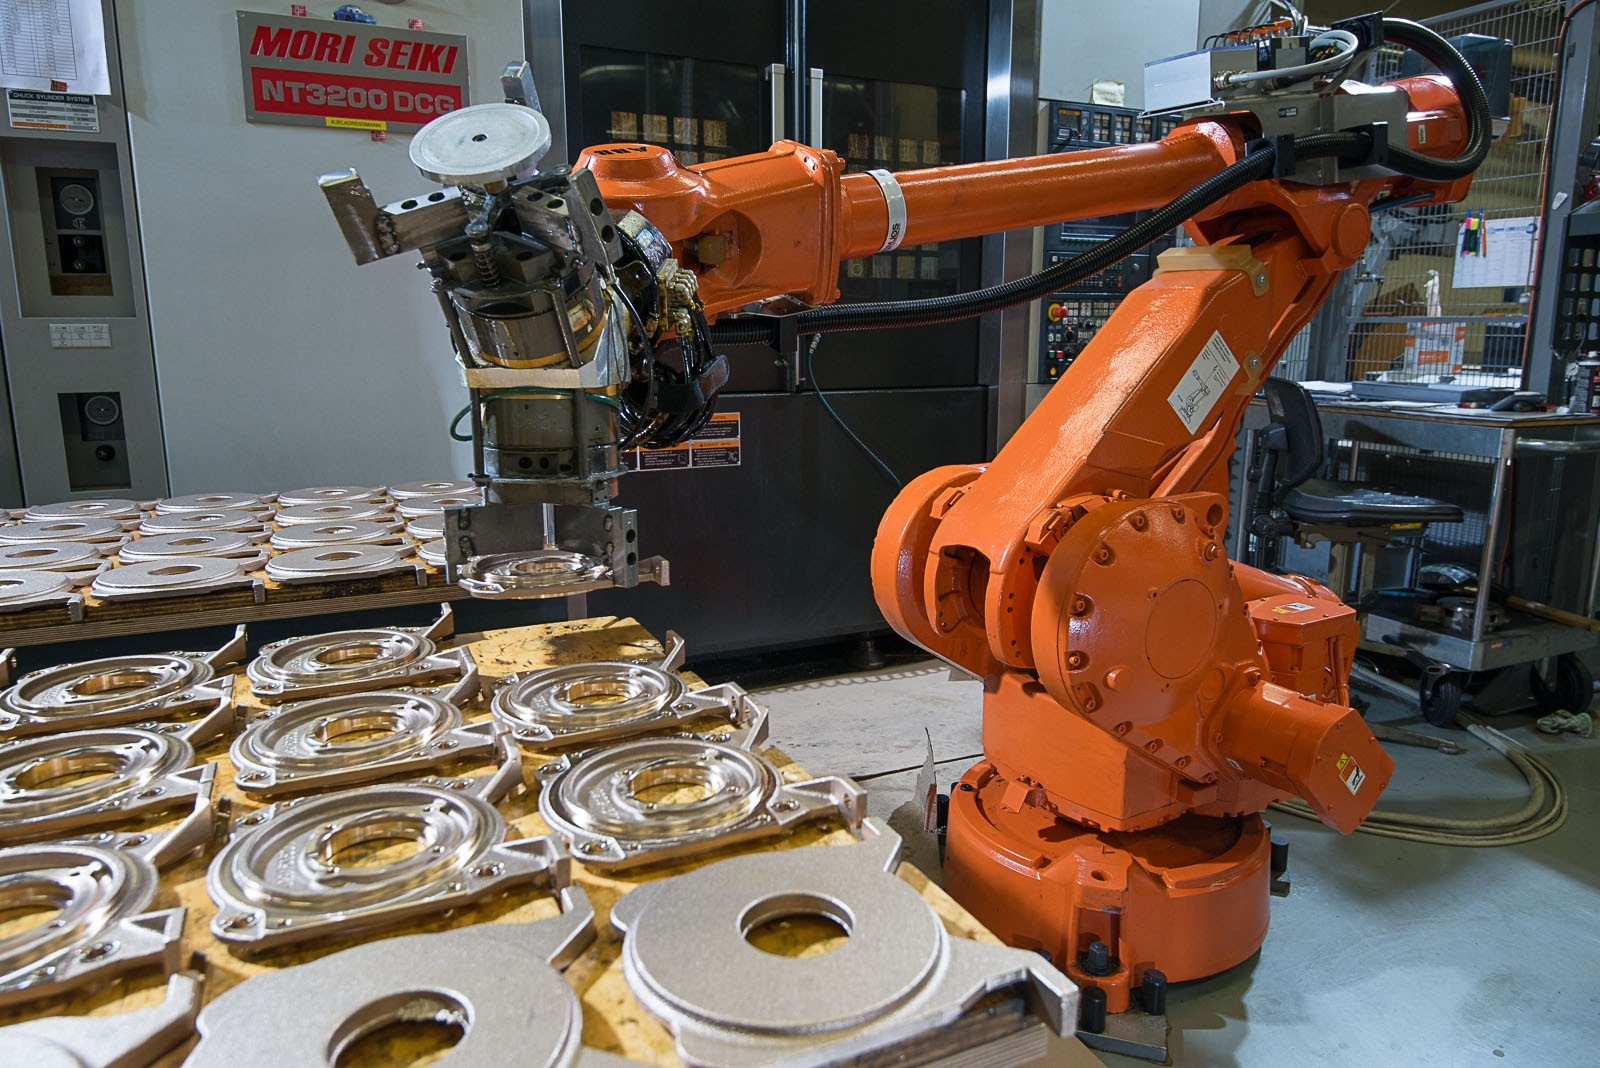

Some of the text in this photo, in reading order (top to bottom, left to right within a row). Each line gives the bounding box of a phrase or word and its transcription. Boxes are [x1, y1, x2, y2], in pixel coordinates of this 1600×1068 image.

[250, 25, 459, 75] MORI SEIKI
[261, 79, 455, 115] NT3200 DCG
